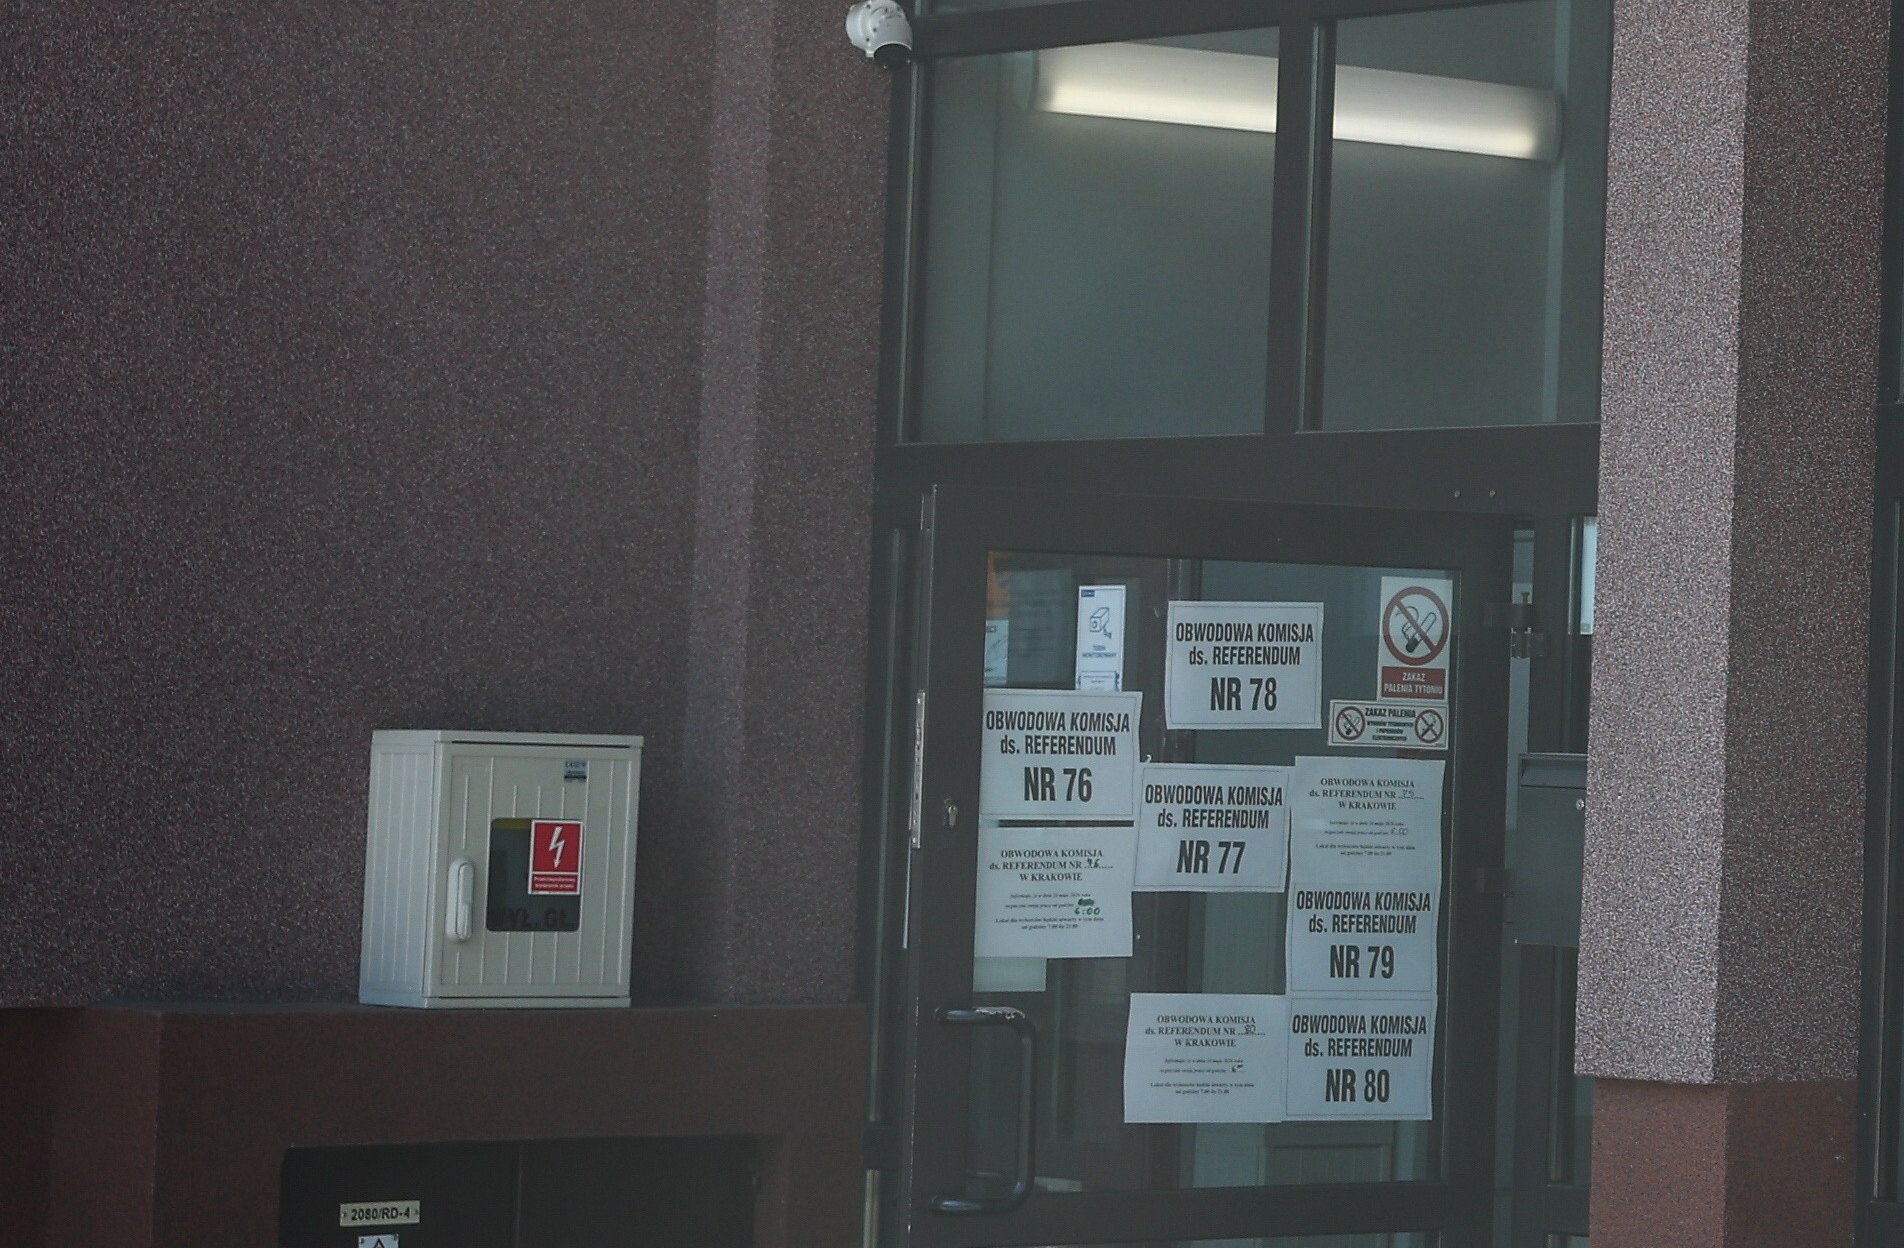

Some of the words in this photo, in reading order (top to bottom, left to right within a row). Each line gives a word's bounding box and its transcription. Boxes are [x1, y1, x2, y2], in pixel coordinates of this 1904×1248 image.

[1176, 622, 1253, 642] OBWODOWA
[1257, 623, 1314, 642] KOMISJA
[1189, 647, 1207, 665] ds.
[1213, 646, 1300, 665] REFERENDUM
[1211, 677, 1241, 711] NR
[1250, 677, 1277, 712] 78
[986, 710, 1066, 731] OBWODOWA
[1070, 712, 1130, 732] KOMISJA
[1000, 735, 1019, 754] ds.
[1025, 735, 1116, 755] REFERENDUM
[1024, 767, 1055, 801] NR
[1063, 767, 1092, 802] 76
[1320, 778, 1375, 787] OBWODOWA
[1377, 779, 1415, 788] KOMISJA
[1145, 784, 1223, 804] OBWODOWA
[1227, 786, 1283, 806] KOMISJA
[1322, 790, 1383, 799] REFERENDUM
[1384, 791, 1396, 799] NR
[1348, 802, 1397, 810] KRAKOWIE
[1158, 809, 1177, 828] ds.
[1182, 808, 1269, 829] REFERENDUM
[1000, 850, 1058, 858] OBWODOWA
[1061, 849, 1103, 858] KOMISJA
[1176, 840, 1210, 873] NR
[1218, 841, 1246, 874] 77
[989, 862, 1000, 870] ds.
[1002, 861, 1067, 870] REFERENDUM
[1069, 861, 1082, 869] NR
[1031, 873, 1082, 882] KRAKOWIE
[1297, 891, 1371, 910] OBWODOWA
[1375, 891, 1431, 912] KOMISJA
[1309, 914, 1327, 933] ds.
[1332, 914, 1417, 934] REFERENDUM
[1330, 945, 1360, 978] NR
[1367, 945, 1395, 979] 79
[1157, 1015, 1213, 1024] OBWODOWA
[1215, 1015, 1256, 1024] KOMISJA
[1292, 1014, 1367, 1034] OBWODOWA
[1370, 1015, 1427, 1035] KOMISJA
[1158, 1027, 1221, 1036] REFERENDUM
[1223, 1027, 1236, 1035] NR
[1185, 1039, 1237, 1047] KRAKOWIE
[1304, 1038, 1323, 1057] ds.
[1328, 1038, 1413, 1057] REFERENDUM
[1325, 1069, 1356, 1102] NR
[1364, 1069, 1390, 1103] 80
[351, 1207, 410, 1221] 2080/RD-4
